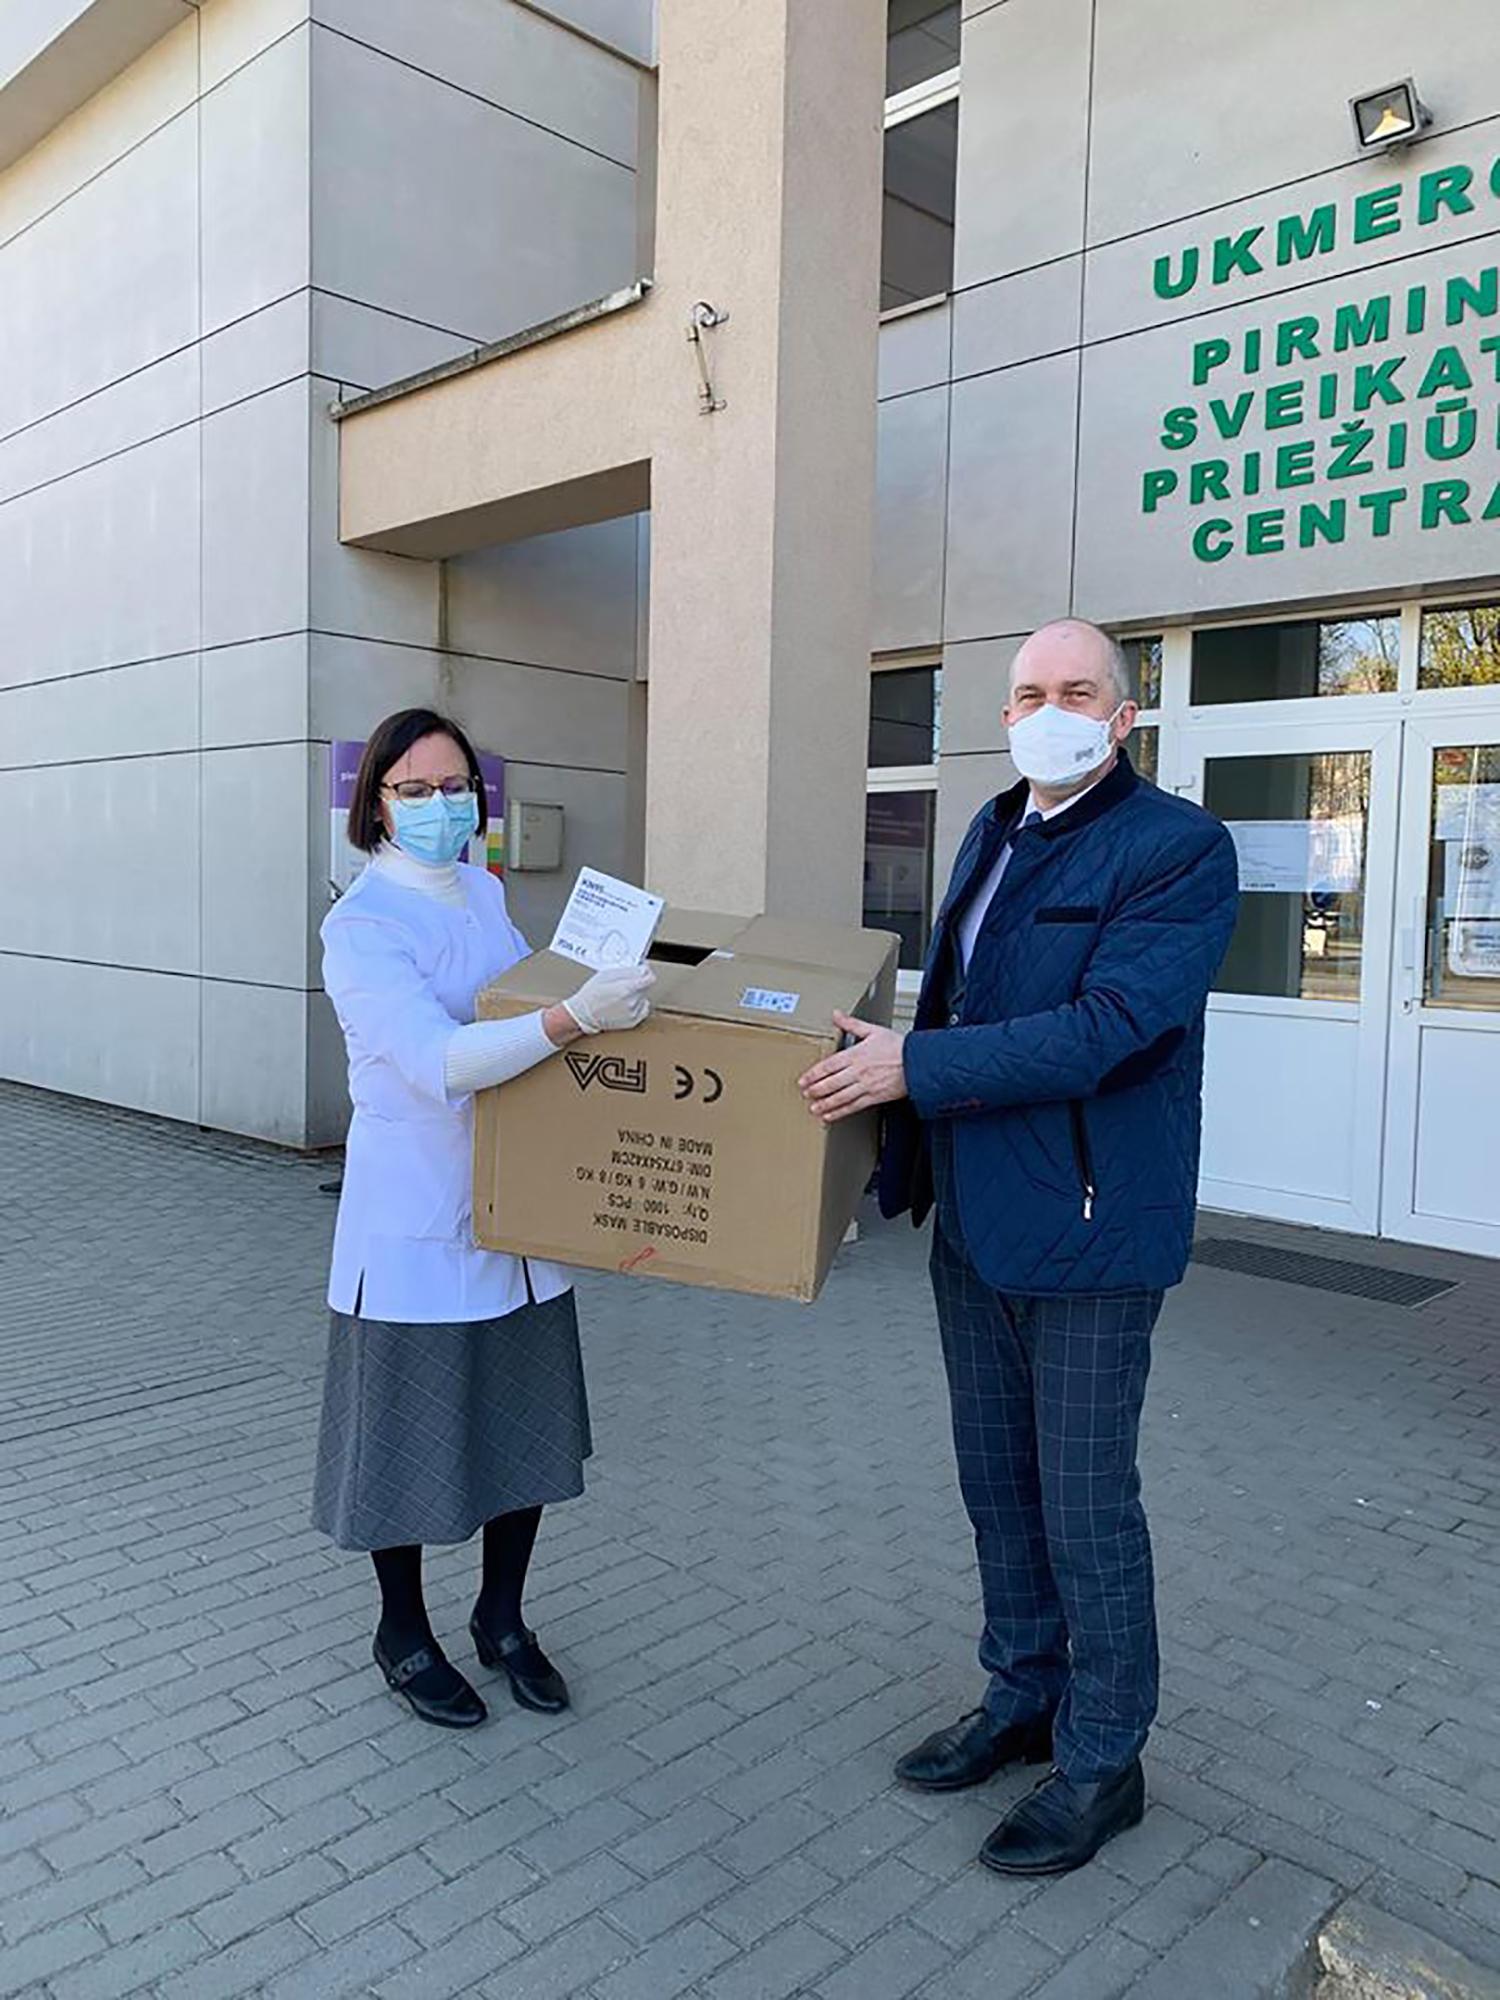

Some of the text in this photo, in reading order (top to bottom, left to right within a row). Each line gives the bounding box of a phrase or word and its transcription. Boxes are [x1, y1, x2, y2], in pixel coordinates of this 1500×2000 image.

[1152, 156, 1500, 299] UKMER
[1191, 266, 1499, 386] PIRMIN
[1142, 397, 1500, 513] PRIEŽIŪ
[564, 1051, 723, 1102] CE FDA
[618, 1129, 713, 1156] MADE IN CHINA
[608, 1193, 632, 1209] PCS
[643, 1199, 670, 1214] 1000
[593, 1213, 708, 1243] DISPOSABLE MASK
